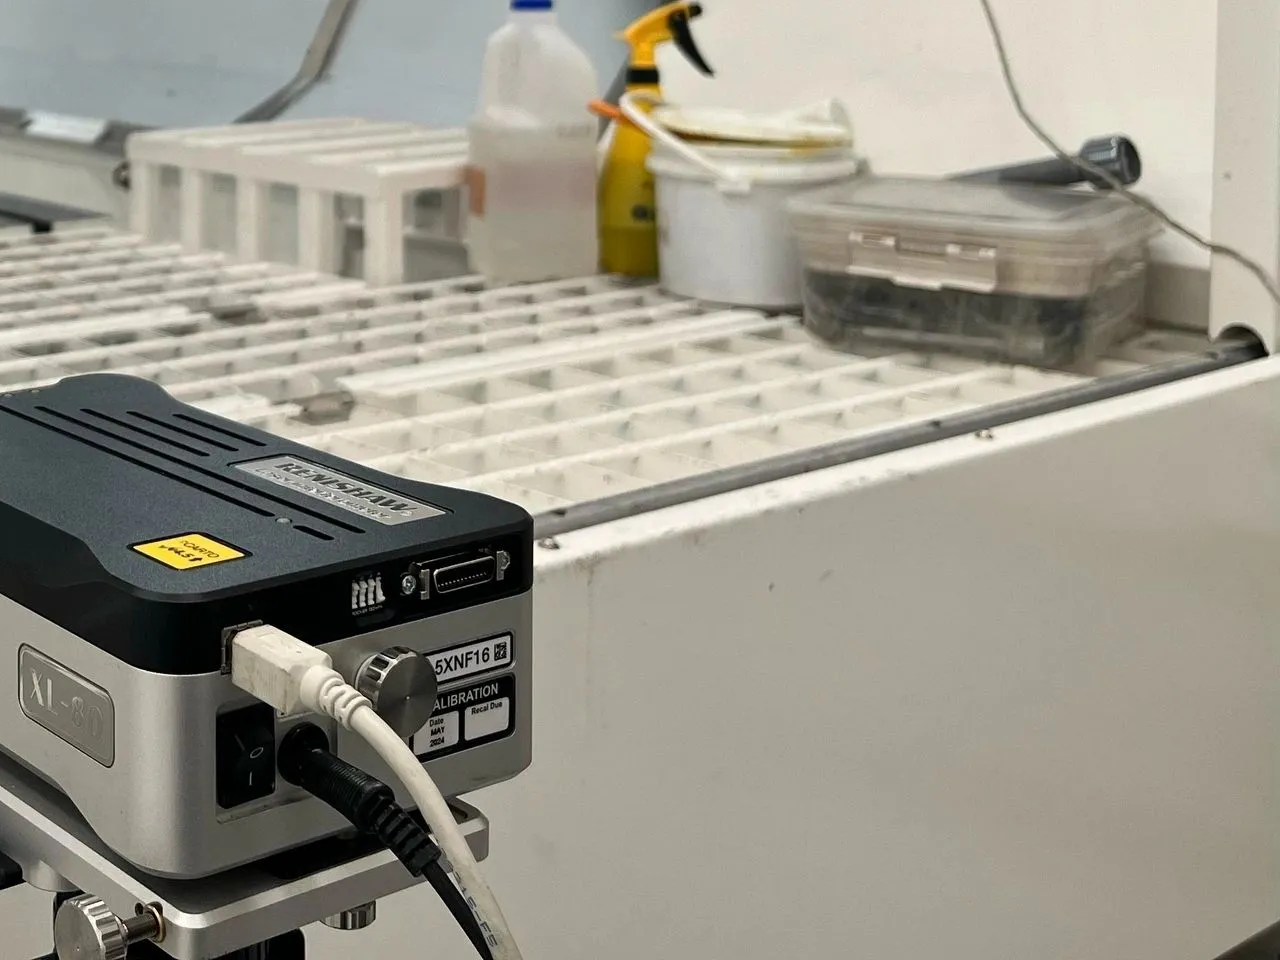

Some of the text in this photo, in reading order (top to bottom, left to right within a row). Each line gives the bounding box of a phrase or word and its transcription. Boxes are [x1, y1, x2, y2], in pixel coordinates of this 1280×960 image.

[275, 462, 418, 512] RENISHAW
[435, 647, 490, 675] 5XNF16
[433, 682, 498, 711] ALIBRATION
[471, 701, 503, 715] Recal Due
[429, 718, 444, 727] Date
[430, 726, 445, 736] MAY
